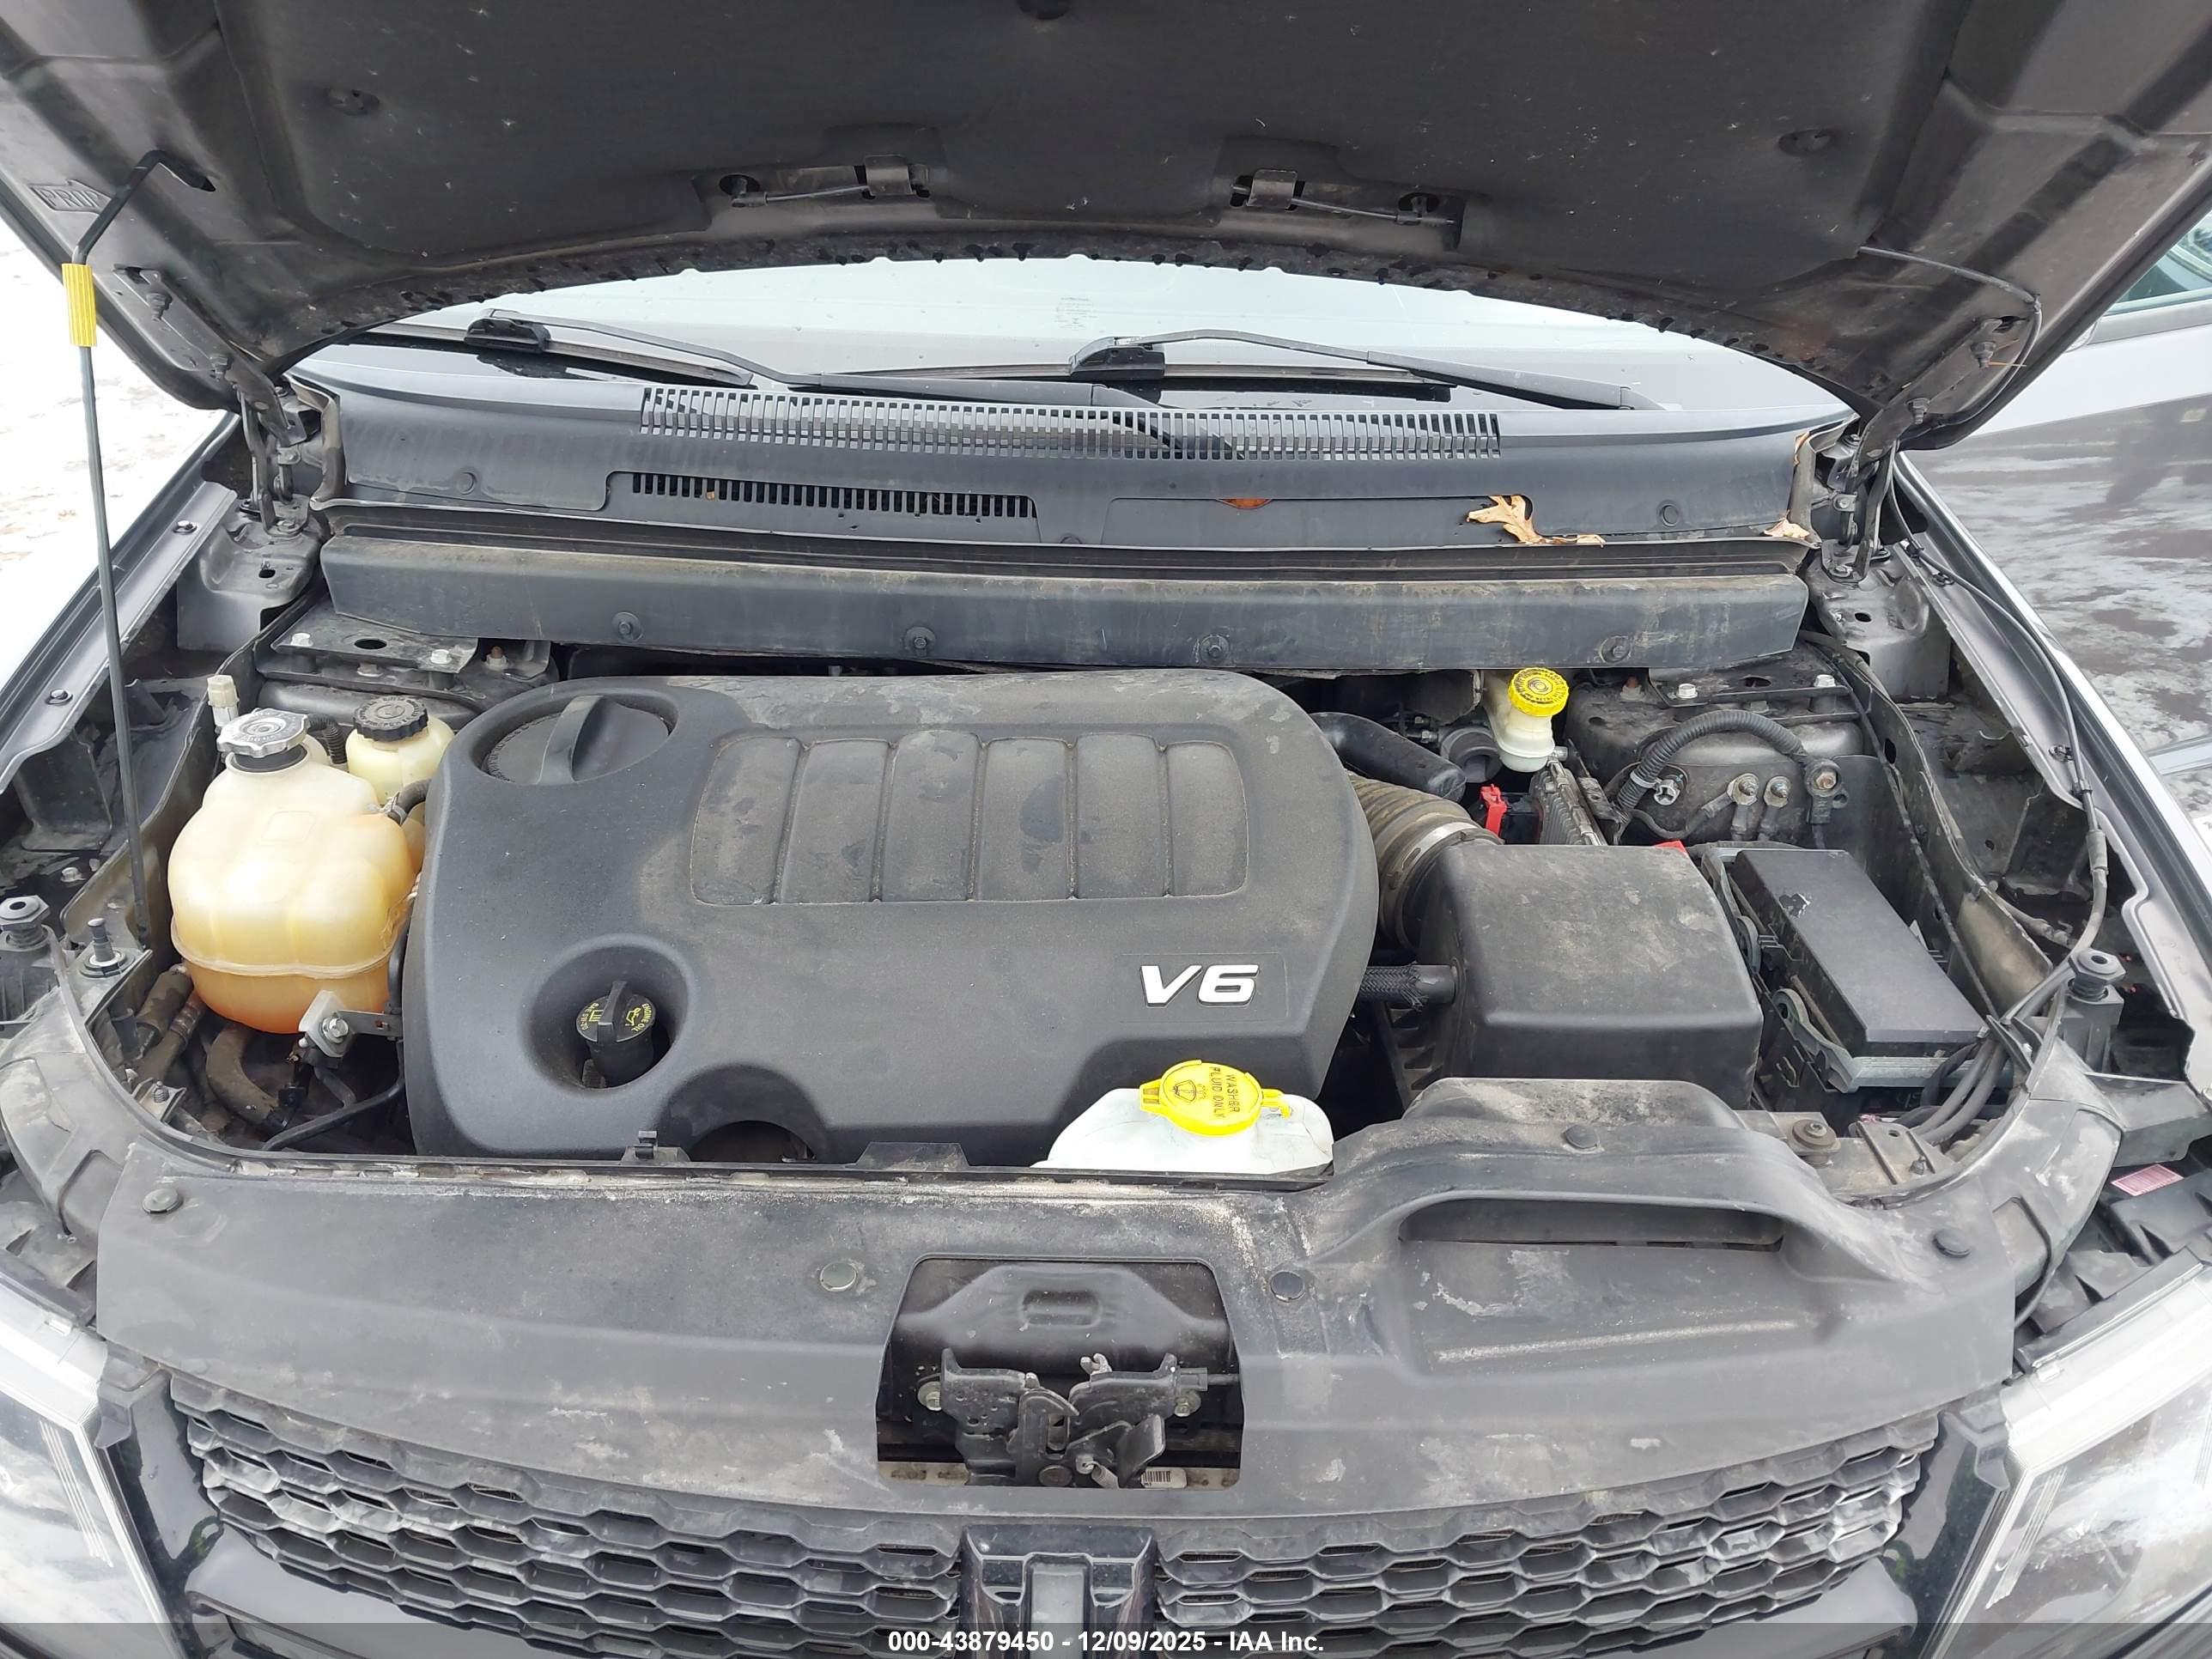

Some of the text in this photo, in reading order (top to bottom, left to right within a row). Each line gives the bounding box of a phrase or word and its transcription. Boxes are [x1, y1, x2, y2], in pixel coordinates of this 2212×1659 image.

[37, 187, 100, 207] PROP
[1140, 964, 1259, 1006] V6
[631, 1003, 653, 1032] ENGINE OIL
[1209, 1066, 1226, 1118] FLUID ONLY
[1226, 1073, 1241, 1114] WASHER
